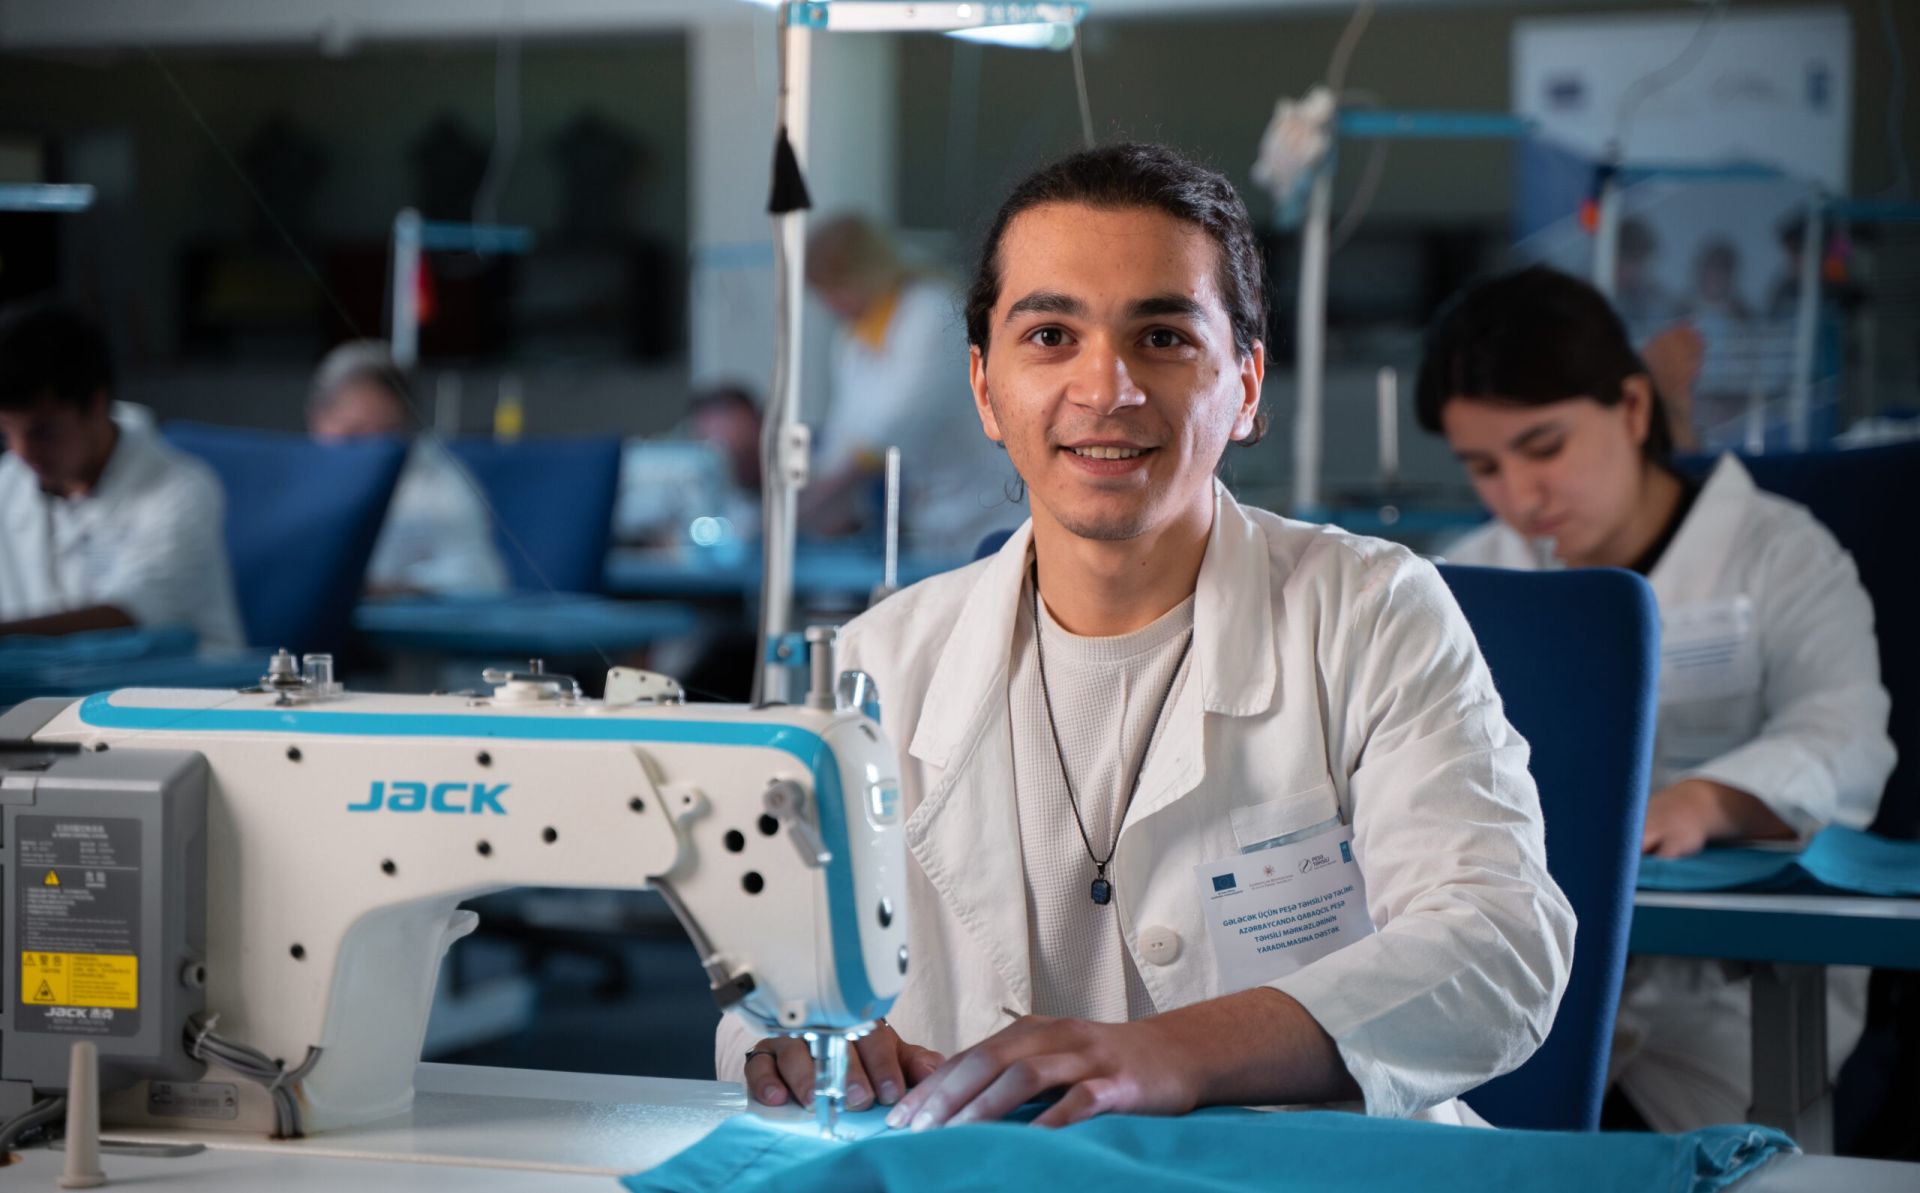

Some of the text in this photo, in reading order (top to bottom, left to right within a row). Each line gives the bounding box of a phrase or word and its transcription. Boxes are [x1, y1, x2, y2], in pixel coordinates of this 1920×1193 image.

[1223, 914, 1257, 927] GƏLƏCƏK
[1258, 908, 1278, 919] ÜÇÜN
[1279, 904, 1297, 913] PEŞƏ
[1323, 893, 1333, 901] VƏ
[1239, 915, 1297, 935] AZƏRBAYCANDA
[1314, 926, 1340, 939] DƏSTƏK
